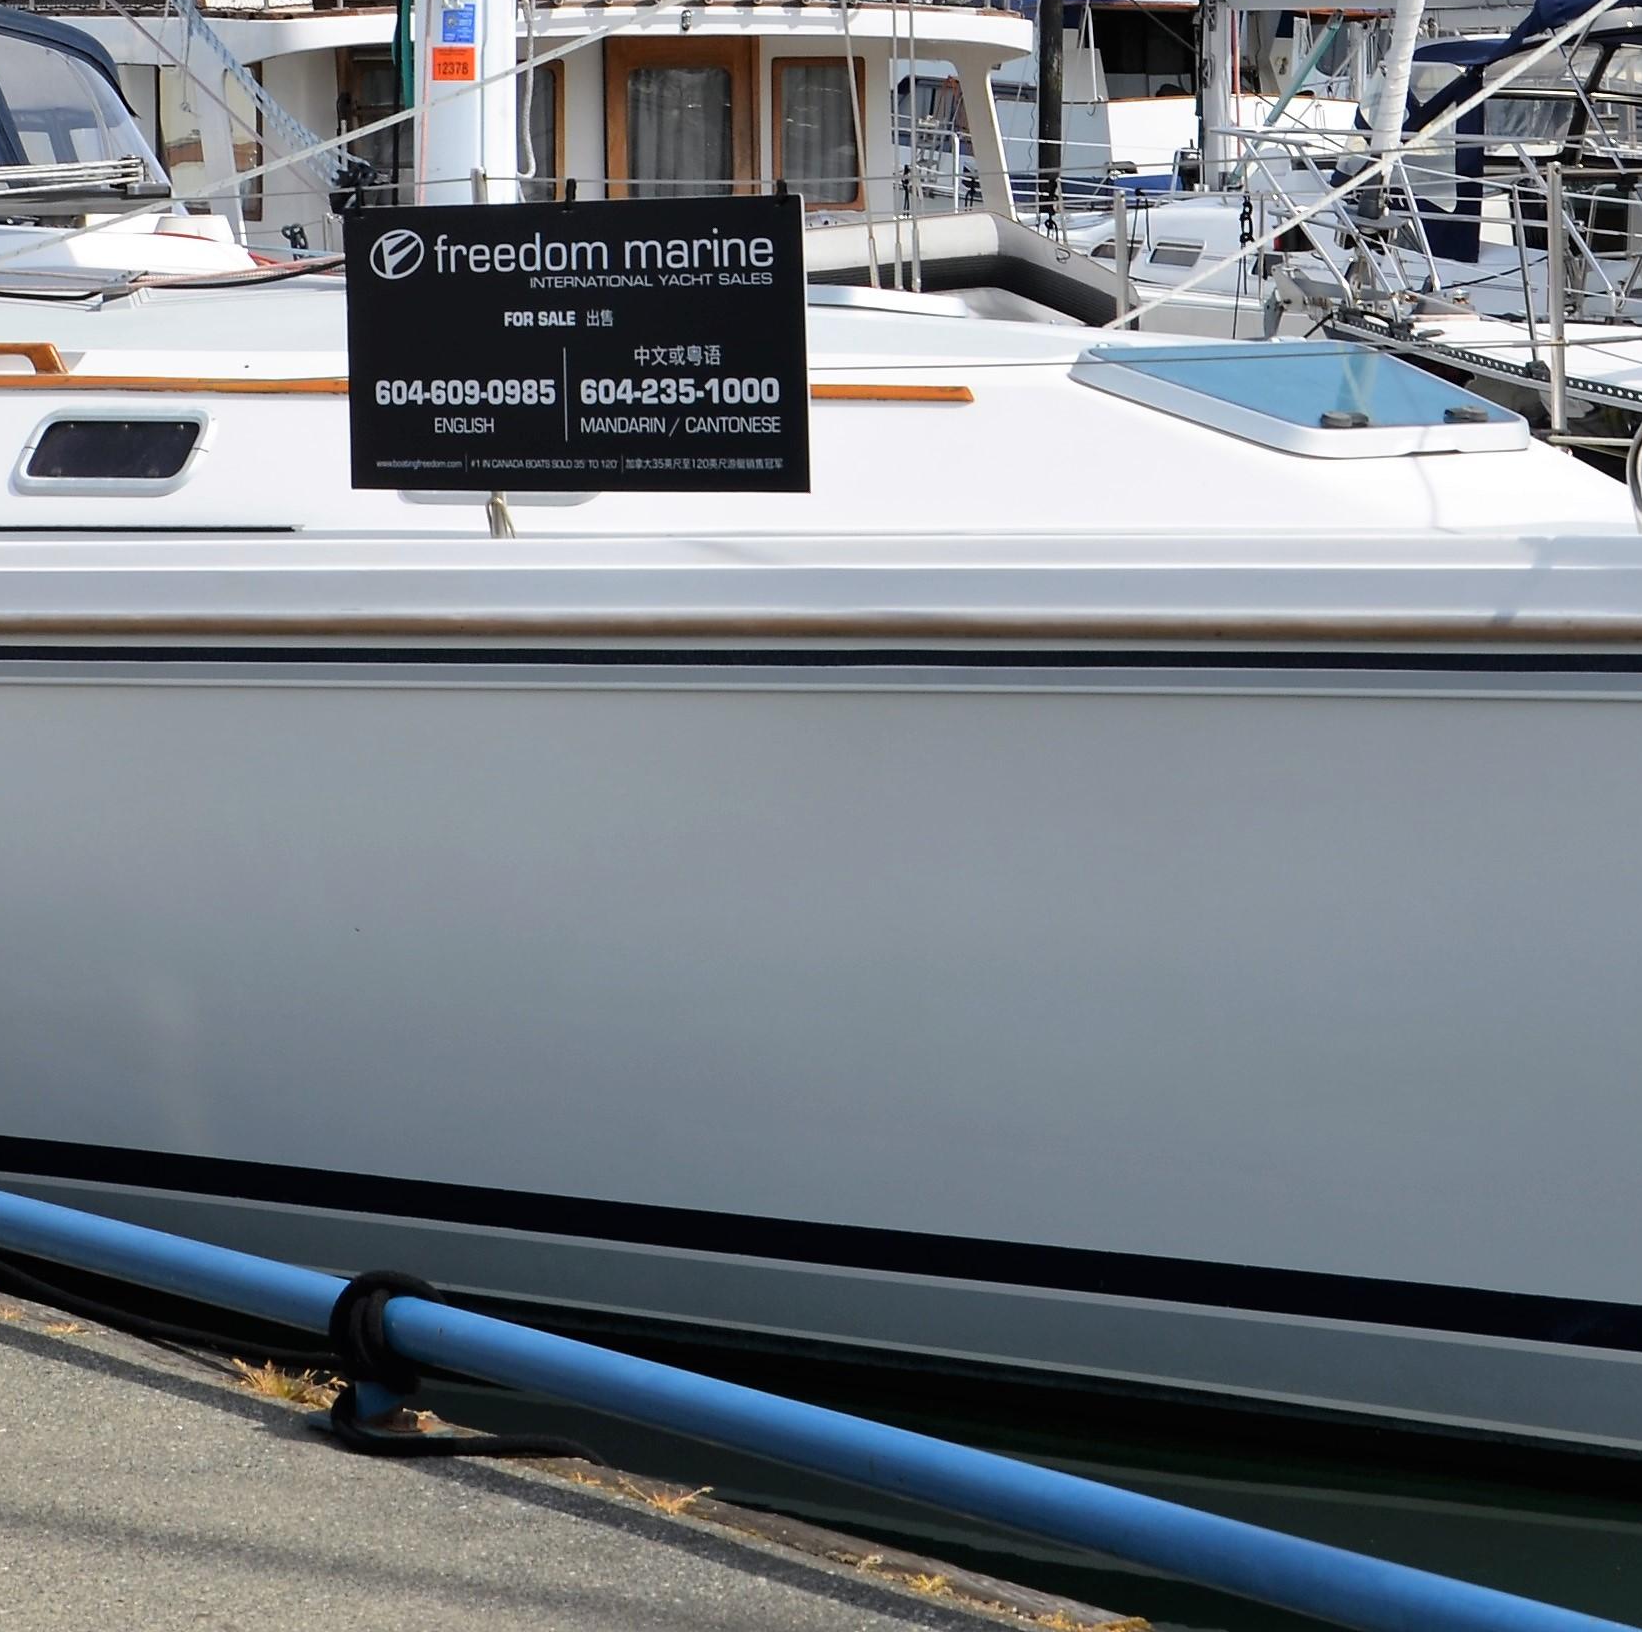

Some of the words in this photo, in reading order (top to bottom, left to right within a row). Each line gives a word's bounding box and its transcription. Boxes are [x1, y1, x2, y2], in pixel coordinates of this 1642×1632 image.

[433, 231, 609, 273] freedom
[624, 227, 774, 270] marine
[529, 274, 653, 289] INTERNATIONAL
[658, 273, 714, 287] YACHT
[718, 271, 773, 286] SALES
[503, 311, 534, 327] FOR
[537, 310, 576, 327] SALE
[586, 309, 614, 327] 出售
[633, 344, 722, 367] 中文或粤语
[375, 378, 556, 406] 604-609-0985
[580, 377, 780, 405] 604-235-1000
[434, 417, 495, 434] ENGLISH
[580, 416, 666, 434] MANDARIN
[668, 417, 681, 438] /
[685, 416, 781, 434] CANTONESE
[492, 459, 524, 469] CANADA
[525, 459, 551, 469] BOATS
[551, 459, 573, 469] SOLD
